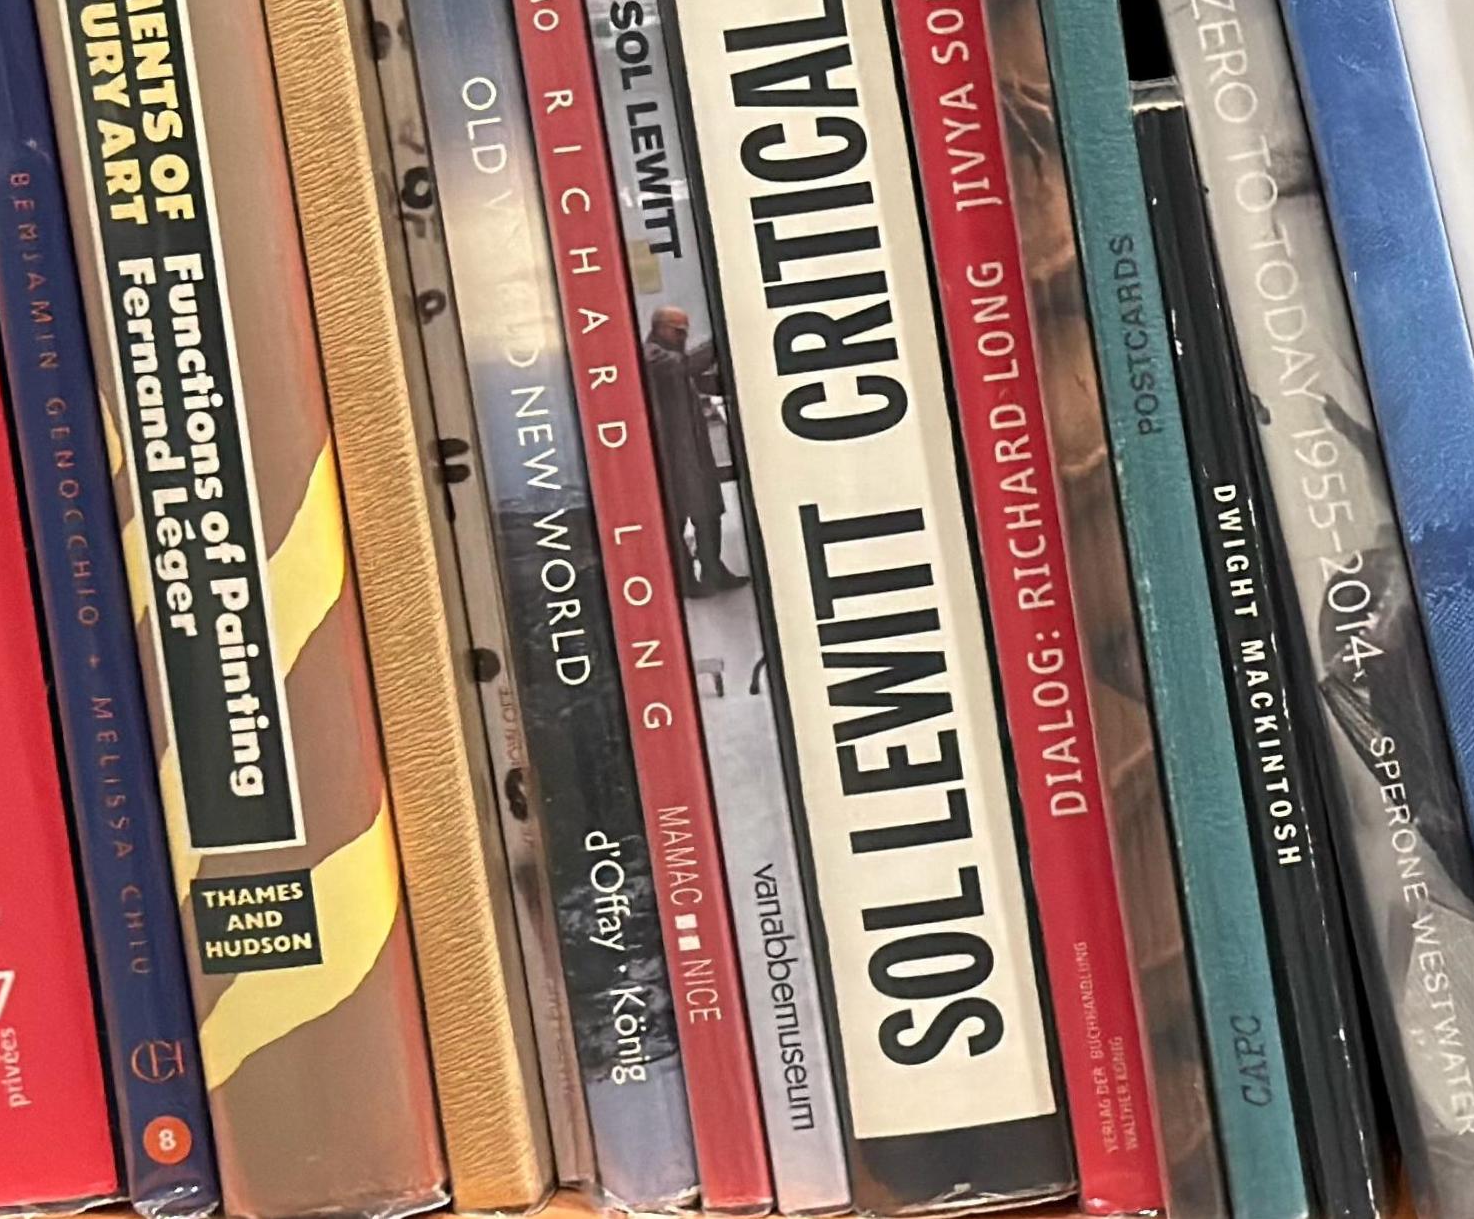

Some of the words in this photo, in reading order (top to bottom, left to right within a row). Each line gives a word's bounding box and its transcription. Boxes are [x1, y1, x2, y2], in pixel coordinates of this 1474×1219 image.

[462, 77, 508, 175] OLD
[609, 0, 649, 90] SOL
[98, 118, 149, 227] ART
[149, 153, 196, 222] OF
[627, 99, 682, 259] LEWITT
[941, 79, 1005, 212] JIVYA
[1228, 136, 1278, 214] TO
[118, 257, 186, 474] Fernand
[162, 252, 224, 501] Functions
[979, 260, 1022, 381] LONG
[1115, 234, 1167, 435] POSTCARDS
[1248, 224, 1326, 408] TODAY
[511, 384, 563, 493] NEW
[989, 404, 1056, 612] RICHARD
[10, 171, 59, 370] BENJAMIN
[45, 396, 102, 627] GENOCCHIO
[90, 693, 136, 861] MELISSA
[120, 884, 153, 975] CHIU
[150, 486, 199, 638] Léger
[200, 509, 247, 565] of
[534, 507, 592, 688] WORLD
[210, 577, 269, 798] Painting
[800, 503, 974, 855] LEWITT
[1028, 623, 1089, 819] DIALOG:
[1212, 483, 1257, 626] DWIGHT
[1240, 640, 1302, 867] MACKINTOSH
[202, 881, 304, 909] THAMES
[204, 932, 314, 960] HUDSON
[226, 910, 285, 933] AND
[582, 832, 629, 953] d'Offay
[609, 985, 651, 1085] König
[860, 864, 1006, 1069] SOL
[754, 864, 814, 1131] vanabbemuseum
